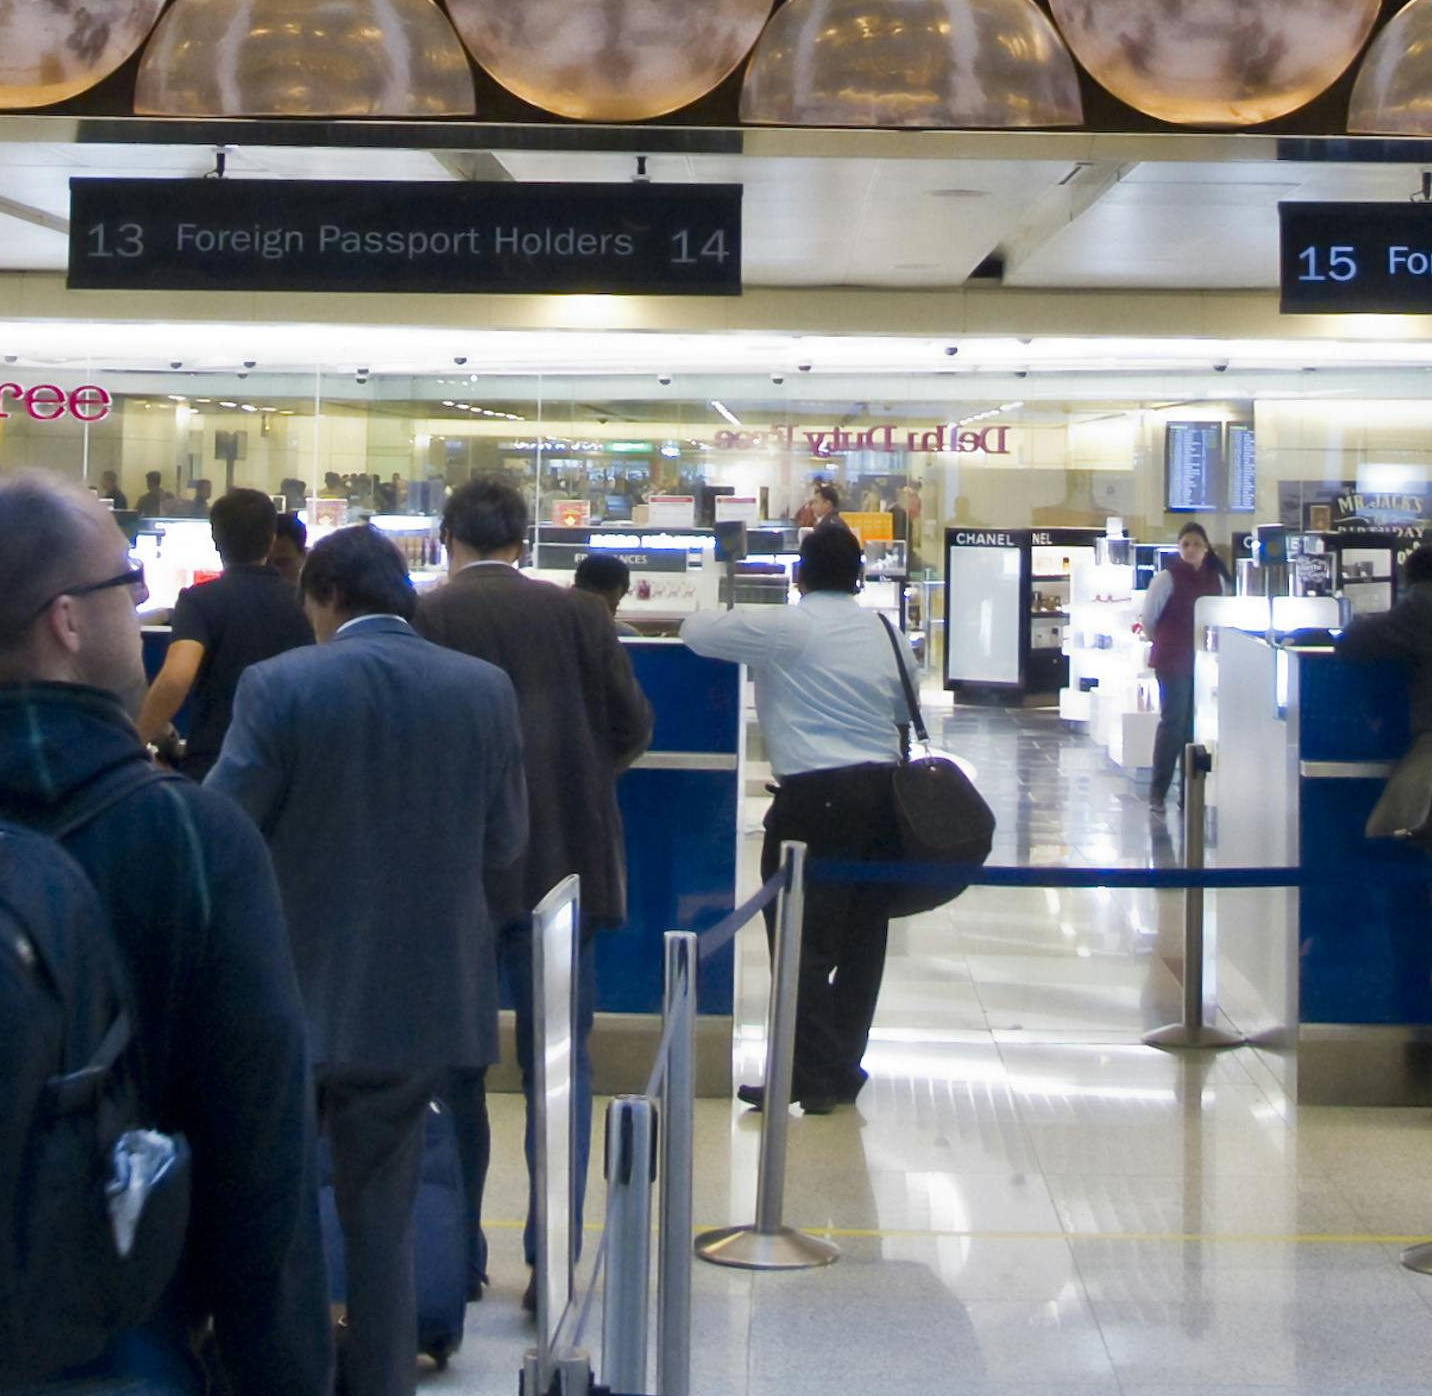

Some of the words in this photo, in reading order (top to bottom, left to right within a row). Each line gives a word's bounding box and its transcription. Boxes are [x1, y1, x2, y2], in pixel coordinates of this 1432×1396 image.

[88, 223, 145, 257] 13
[177, 223, 304, 259] Foreign
[319, 225, 479, 259] Passport
[495, 227, 633, 255] Holders
[671, 229, 730, 263] 14
[1299, 246, 1356, 281] 15
[955, 532, 1015, 546] CHANEL
[1032, 532, 1053, 545] NEL
